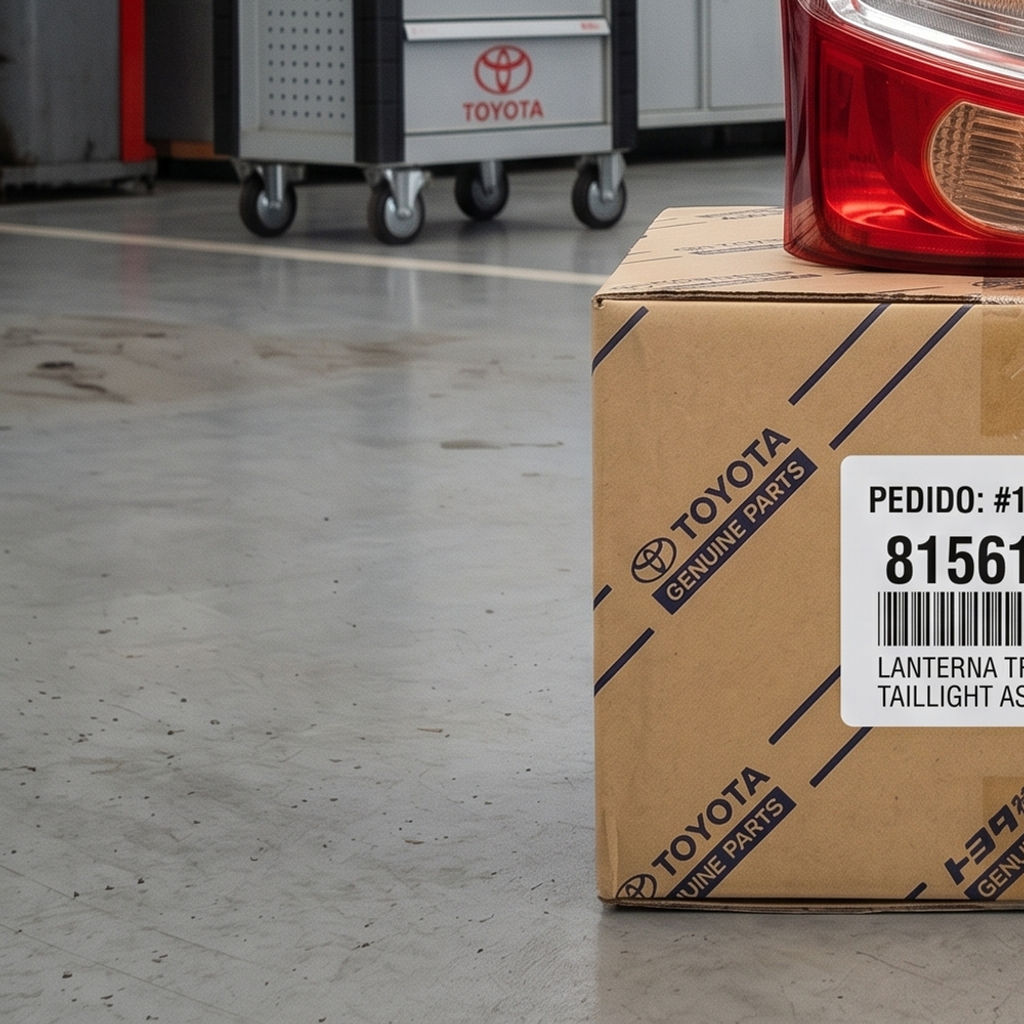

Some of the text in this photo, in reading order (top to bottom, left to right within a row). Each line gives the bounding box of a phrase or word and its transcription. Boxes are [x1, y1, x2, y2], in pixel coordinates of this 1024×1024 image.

[463, 99, 544, 121] TOYOTA
[670, 428, 791, 539] TOYOTA
[869, 485, 984, 514] PEDIDO:
[666, 460, 805, 602] GENUINE PARTS
[877, 684, 994, 708] TAILLIGHT
[878, 656, 998, 679] LANTERNA
[651, 766, 771, 876] TOYOTA
[676, 797, 784, 897] UINE PARTS
